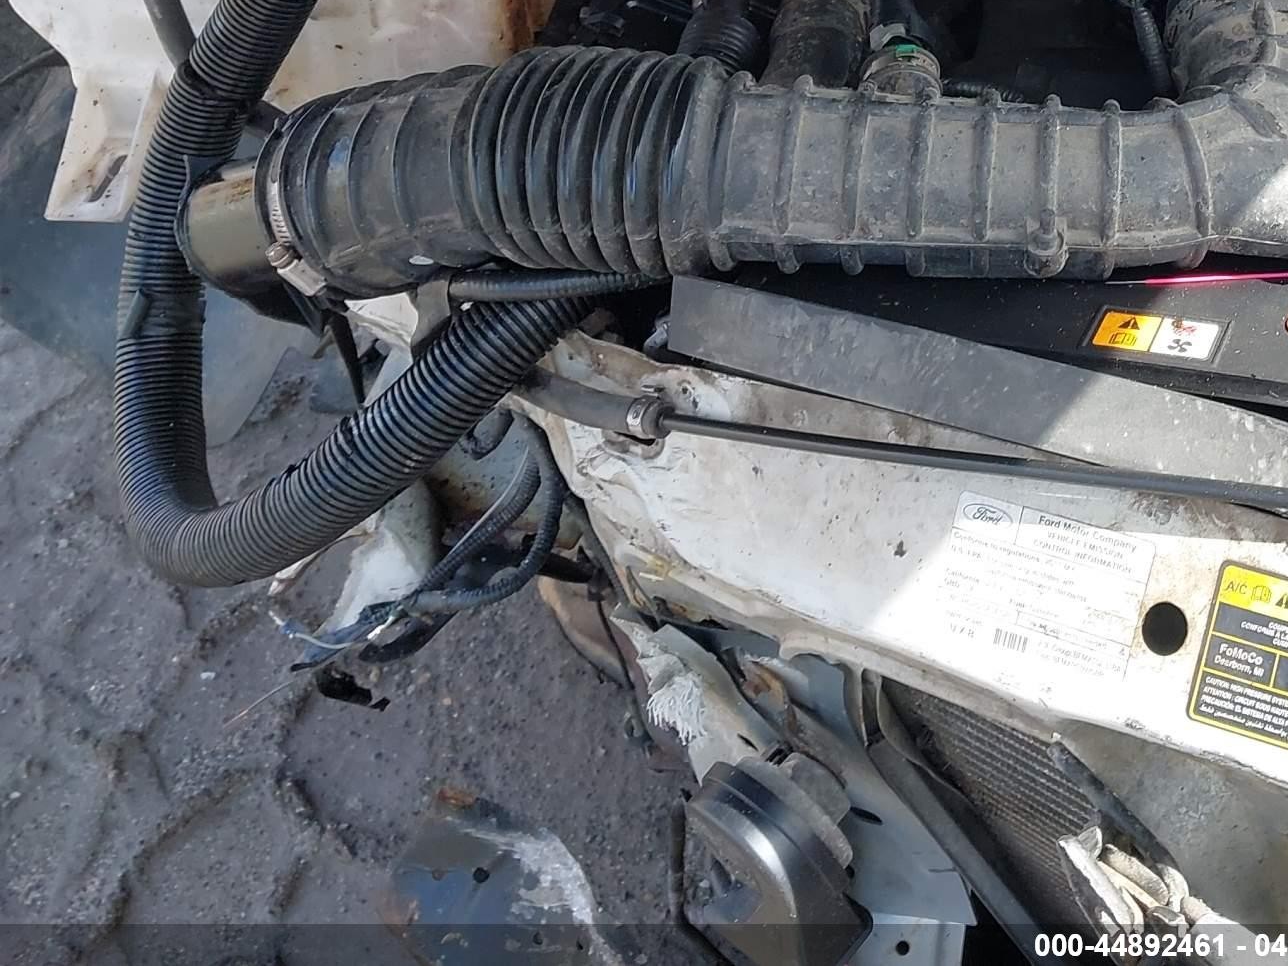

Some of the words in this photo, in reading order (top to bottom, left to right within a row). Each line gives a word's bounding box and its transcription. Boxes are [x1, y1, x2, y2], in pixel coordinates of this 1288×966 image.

[972, 504, 1003, 526] Ford
[1038, 515, 1060, 529] Ford
[1062, 523, 1089, 537] Motor
[1091, 532, 1136, 552] Company
[1225, 579, 1247, 595] A/C
[1280, 632, 1288, 641] LA
[1218, 642, 1264, 665] FoMoCo
[1213, 654, 1253, 674] Dearborn,
[1253, 666, 1264, 677] MI
[1203, 685, 1231, 699] ATTENTION
[1234, 695, 1255, 707] CIRCUIT
[1255, 701, 1270, 711] SOUS
[1270, 706, 1288, 717] HAUTE
[1229, 683, 1243, 693] HIGH
[1243, 687, 1271, 701] PRESSURE
[1241, 707, 1263, 719] SISTEMA
[1263, 713, 1272, 722] DE
[1271, 716, 1284, 726] ALTA
